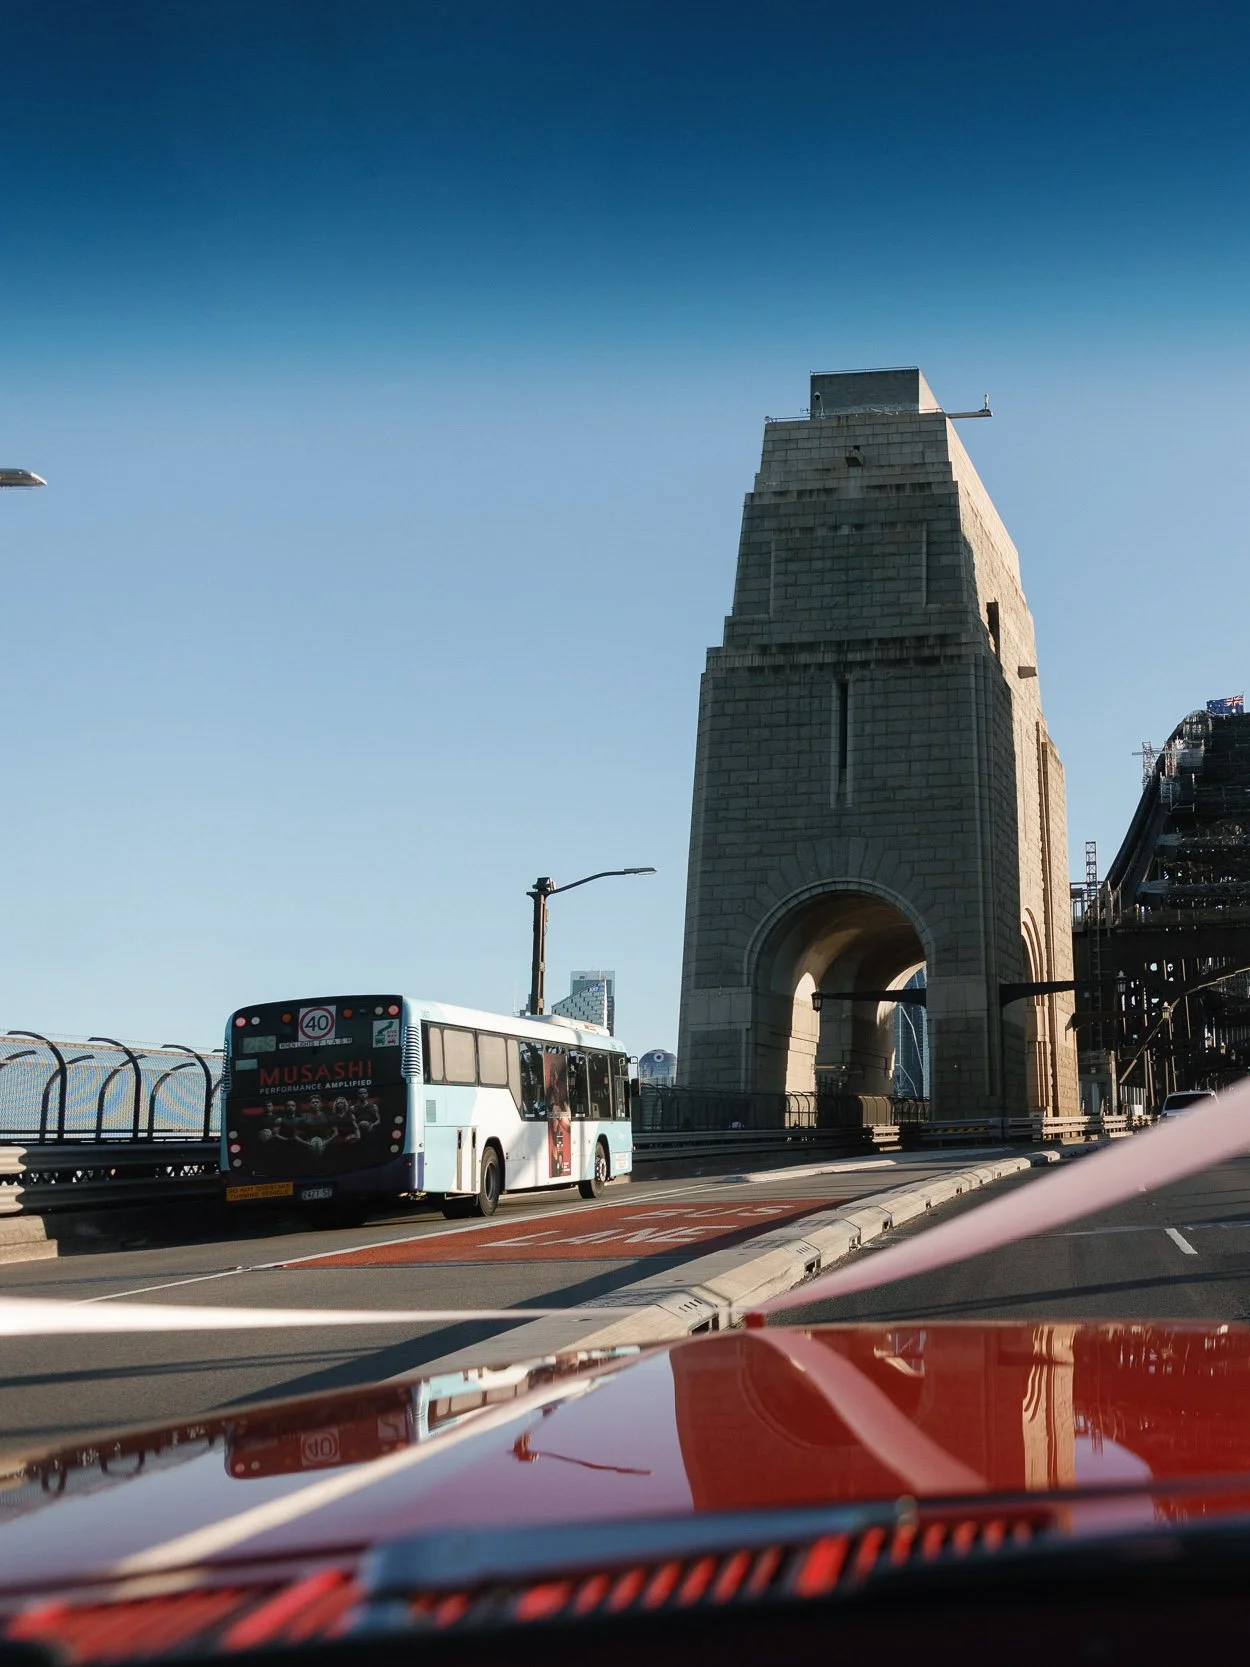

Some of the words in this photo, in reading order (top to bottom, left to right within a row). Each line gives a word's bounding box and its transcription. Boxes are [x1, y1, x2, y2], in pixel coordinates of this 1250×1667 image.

[304, 1015, 329, 1032] 40
[259, 1060, 373, 1086] MUSASHI
[259, 1082, 323, 1095] PERFORMANCE
[325, 1079, 373, 1089] AMPLIFIED
[256, 1183, 289, 1191] OVERTAKE
[622, 1205, 795, 1220] BUS
[477, 1224, 738, 1248] LANE
